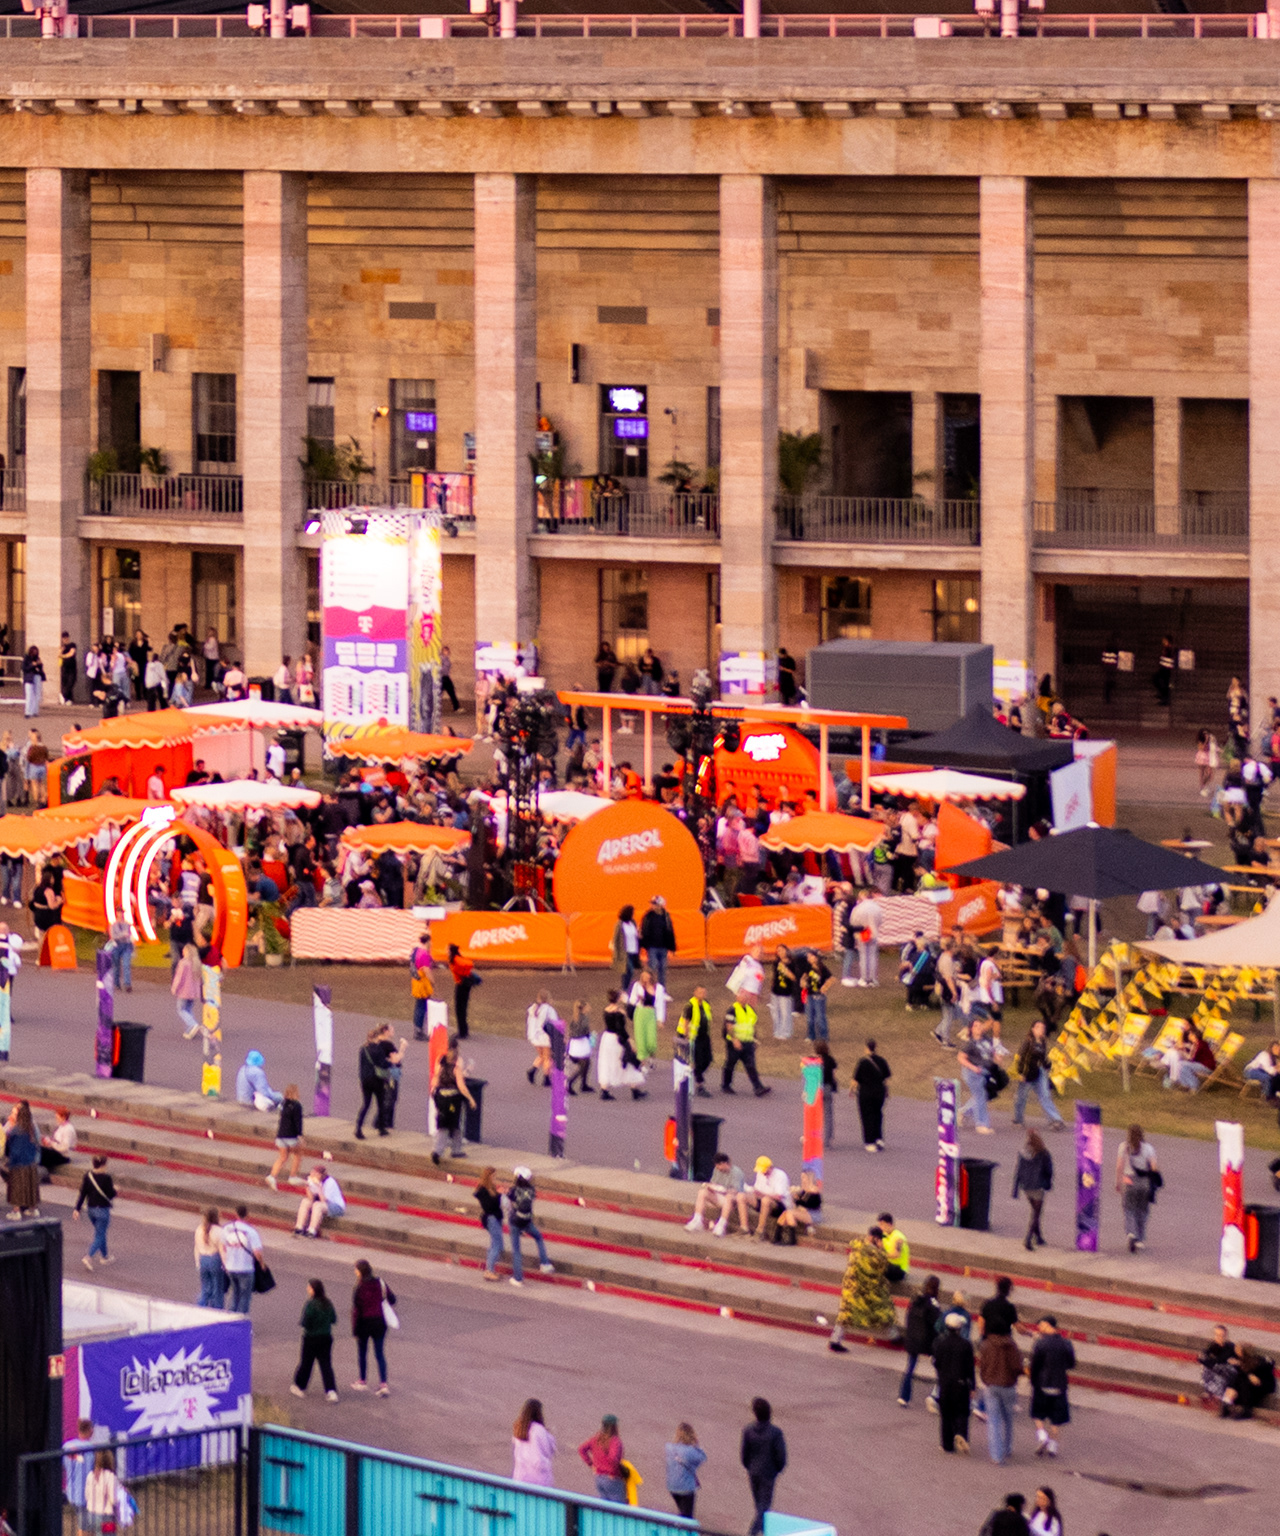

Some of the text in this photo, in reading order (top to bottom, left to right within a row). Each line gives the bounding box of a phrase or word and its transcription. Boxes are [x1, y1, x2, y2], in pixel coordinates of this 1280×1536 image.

[597, 829, 664, 864] APEROL
[469, 924, 529, 949] APEROL
[743, 917, 798, 945] APEROL
